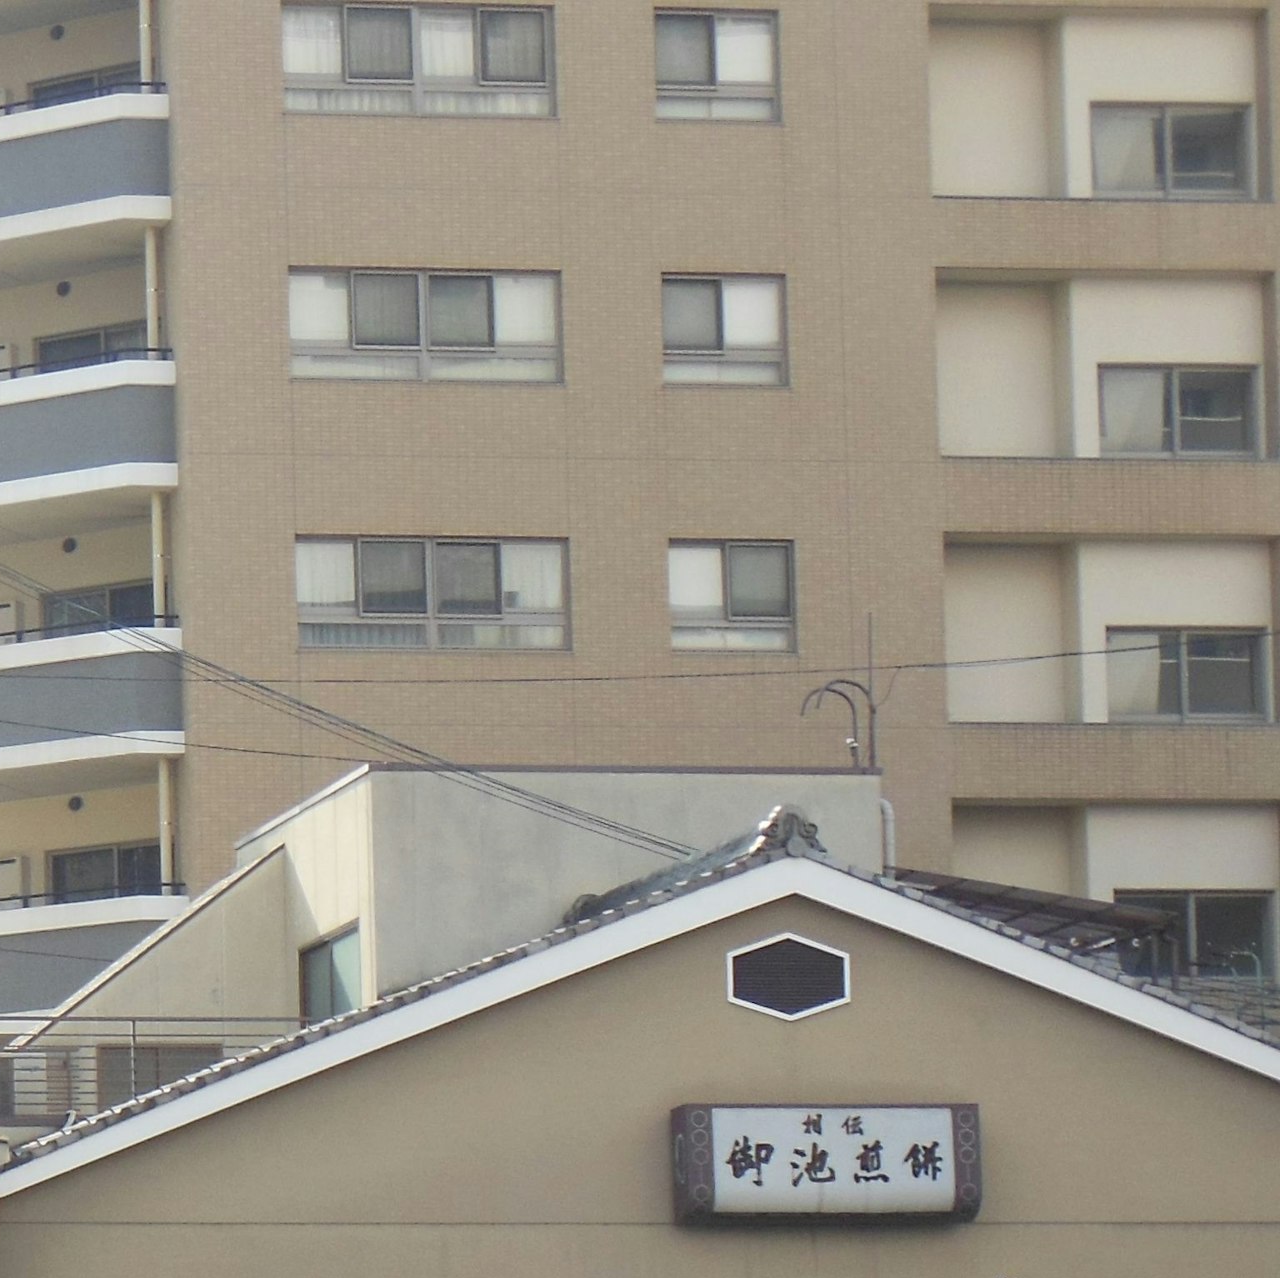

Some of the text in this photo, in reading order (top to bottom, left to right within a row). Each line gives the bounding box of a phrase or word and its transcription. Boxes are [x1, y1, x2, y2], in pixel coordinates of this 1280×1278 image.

[802, 1113, 865, 1136] 相伝
[724, 1135, 944, 1187] 御池煎餅
